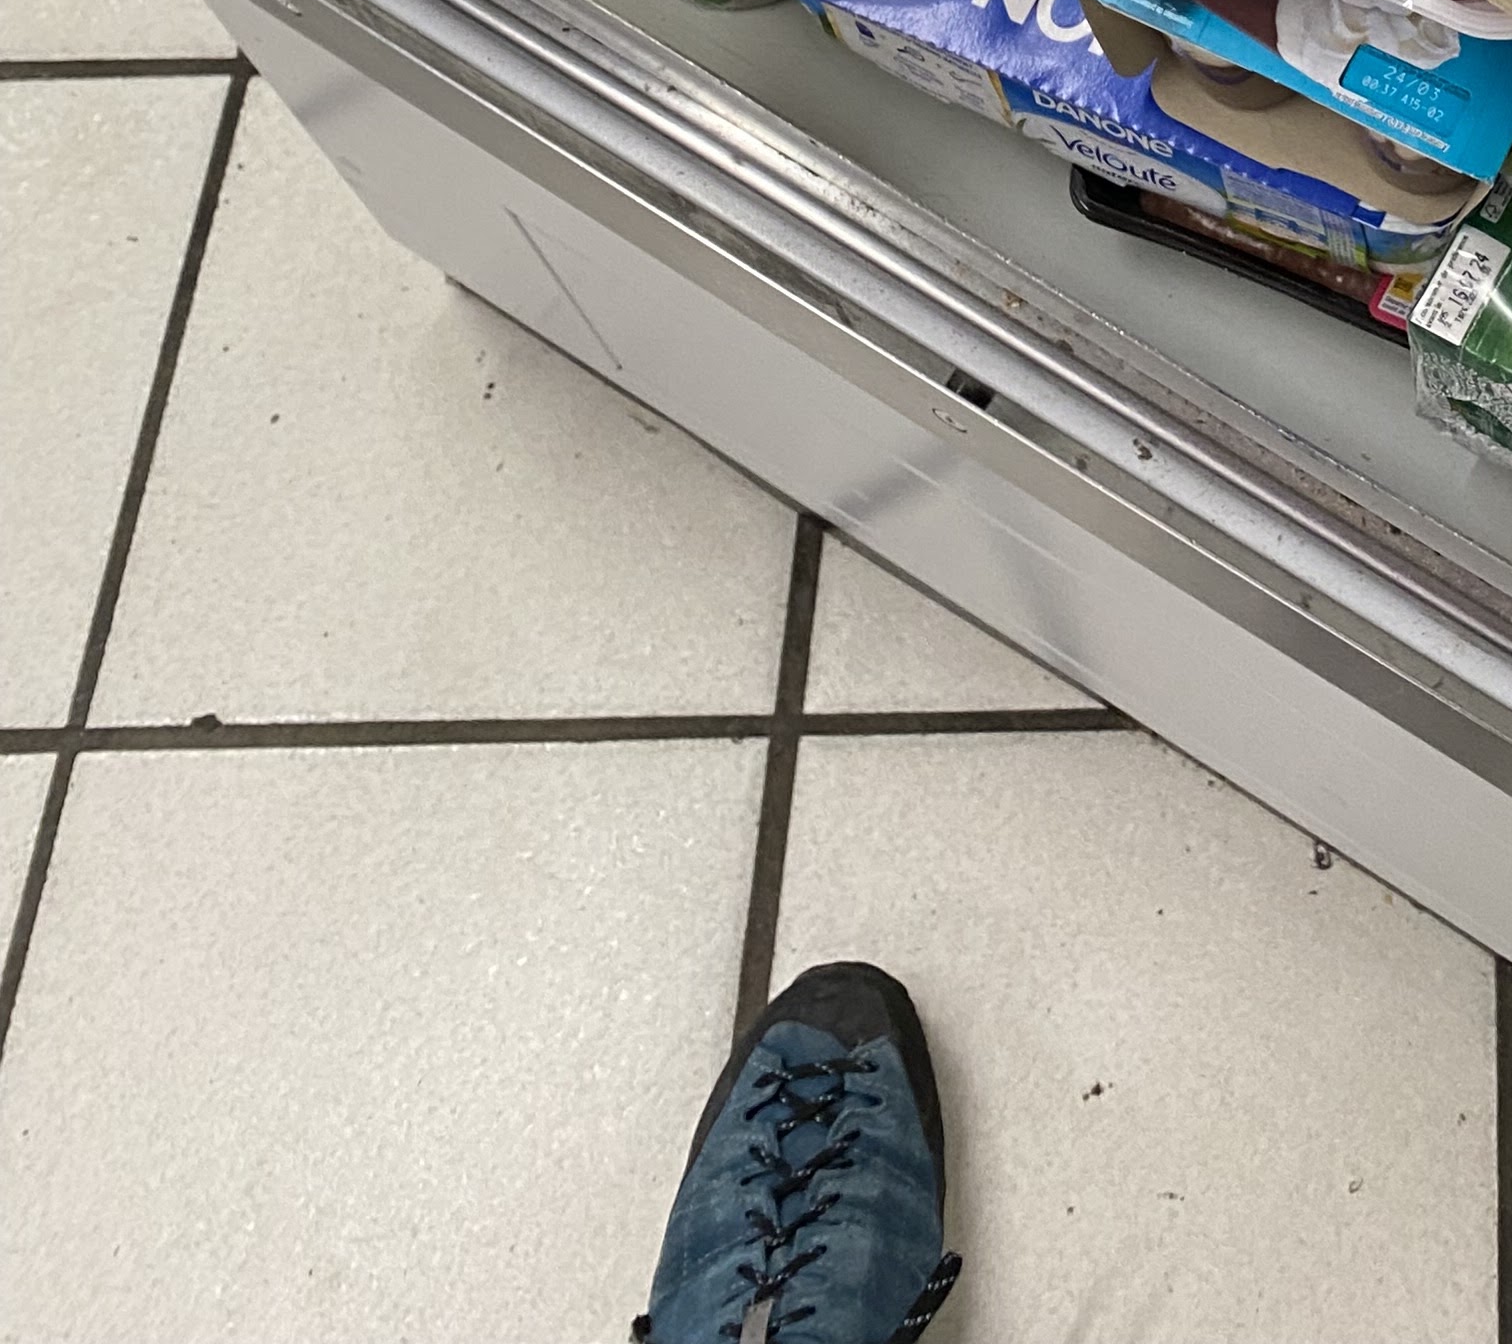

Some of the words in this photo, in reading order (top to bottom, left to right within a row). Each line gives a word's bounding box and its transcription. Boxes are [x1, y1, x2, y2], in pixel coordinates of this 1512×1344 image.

[1382, 65, 1441, 102] 24/03
[1401, 93, 1444, 123] A15-02
[1051, 125, 1178, 192] Velouté
